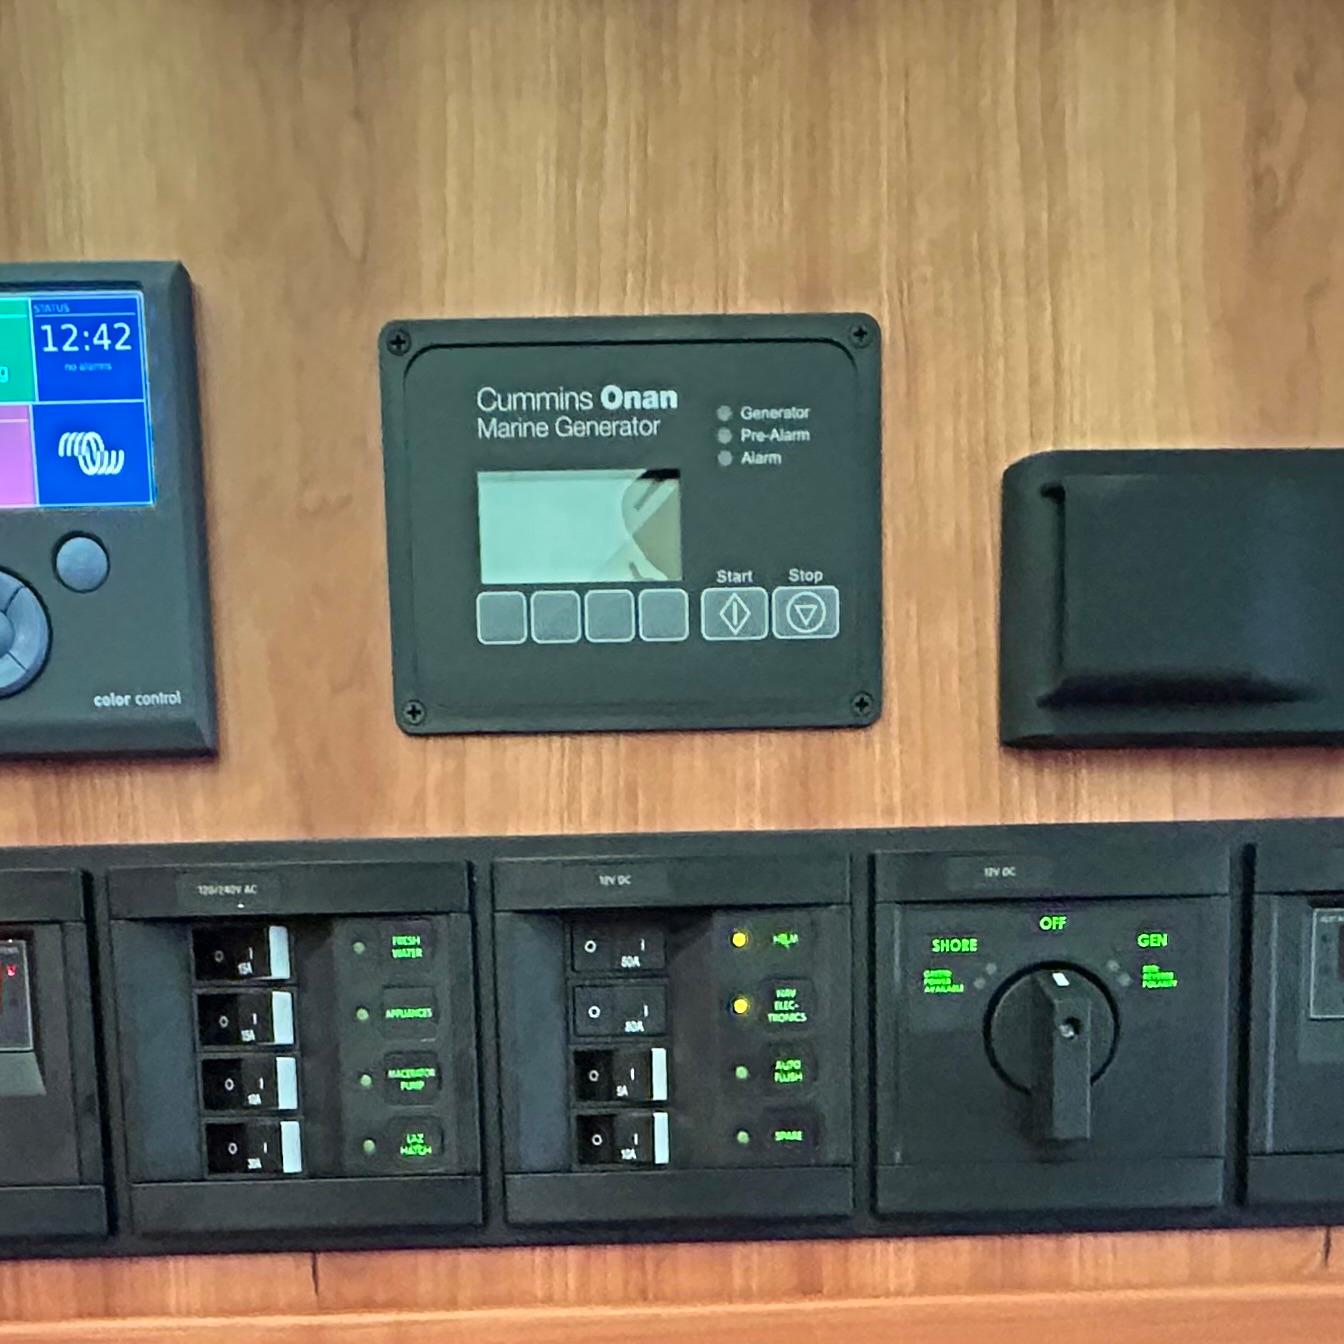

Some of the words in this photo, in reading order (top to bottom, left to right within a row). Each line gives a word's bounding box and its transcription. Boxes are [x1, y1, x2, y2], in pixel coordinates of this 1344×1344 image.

[33, 304, 70, 314] STATUS
[40, 322, 133, 352] 12:42
[476, 386, 594, 412] Cummins
[600, 384, 678, 410] Onan
[740, 406, 811, 420] Generator
[477, 417, 549, 439] Marine
[555, 415, 661, 438] Generator
[741, 427, 811, 442] Pre-Alarm
[741, 451, 782, 465] Alarm
[716, 569, 753, 583] Start
[788, 568, 824, 584] Stop
[93, 692, 131, 707] color
[135, 690, 181, 706] control
[1002, 867, 1016, 877] DC
[244, 884, 257, 894] AC
[1039, 916, 1067, 930] OFF
[392, 936, 421, 946] FRESH
[931, 938, 978, 952] SHORE
[1137, 933, 1168, 948] GEN
[392, 948, 423, 958] WATER
[385, 1008, 432, 1018] APPLIANCES
[774, 1071, 803, 1082] FLUSH
[400, 1146, 432, 1156] HATCH
